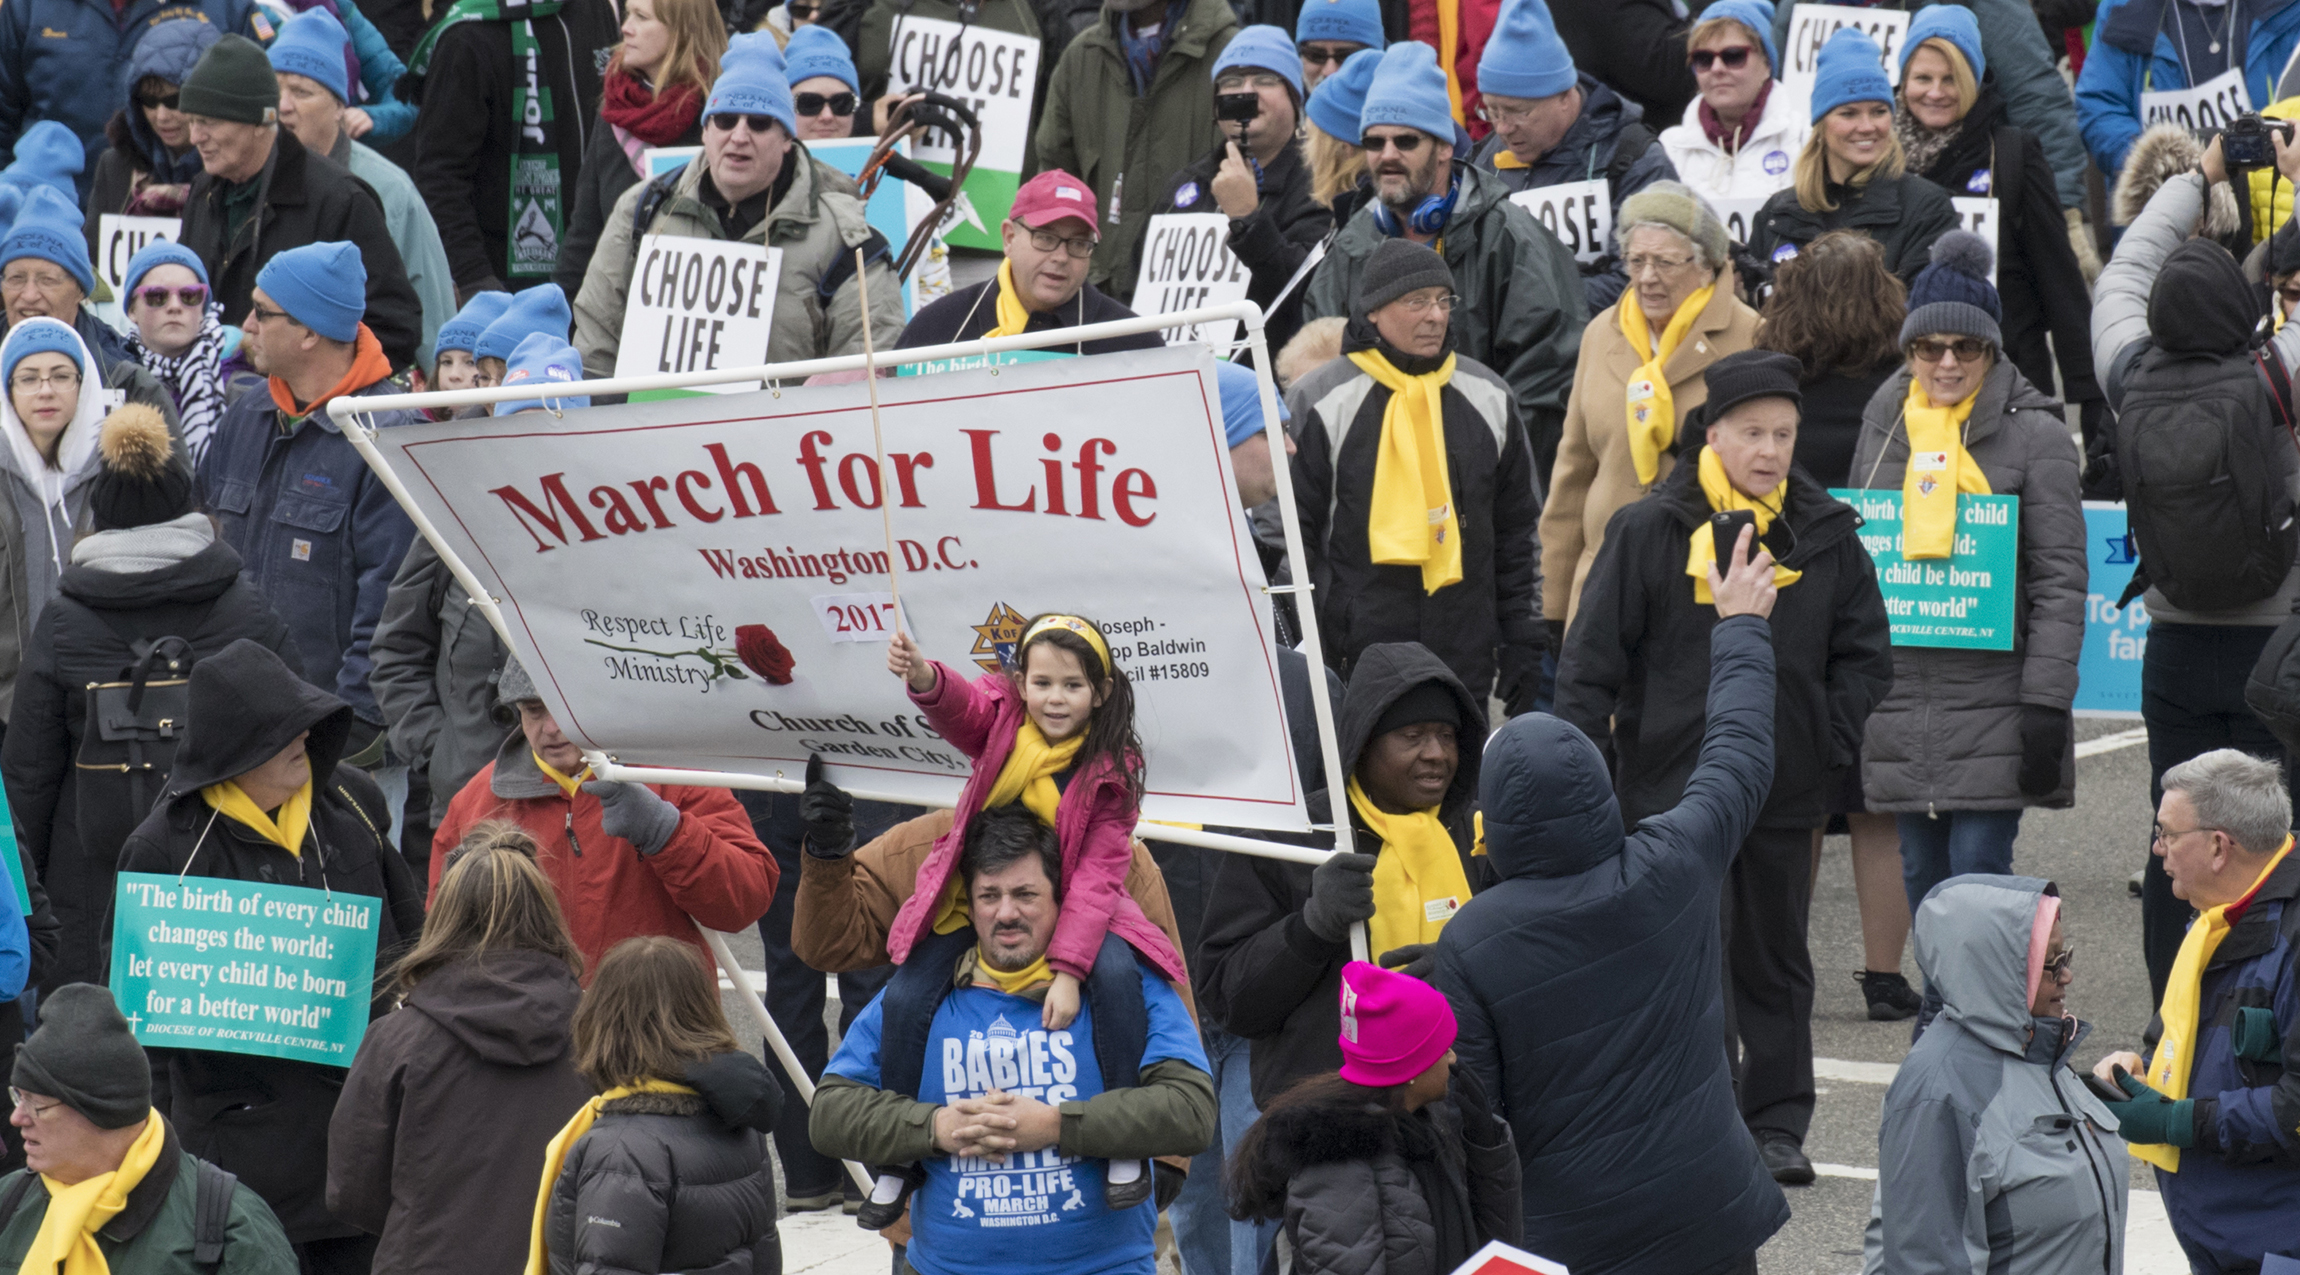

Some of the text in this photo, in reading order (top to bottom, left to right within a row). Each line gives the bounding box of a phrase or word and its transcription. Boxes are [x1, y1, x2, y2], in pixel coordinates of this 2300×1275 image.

[900, 30, 1026, 99] CHOOSE
[1522, 194, 1603, 254] OSE
[641, 248, 768, 319] CHOOSE
[658, 314, 725, 374] LIFE
[488, 428, 1157, 554] March for Life
[1863, 498, 1896, 521] birth
[1964, 503, 2008, 526] child
[697, 535, 979, 586] Washington D.C.
[1885, 562, 1922, 585] child
[1925, 564, 1945, 586] be
[1949, 565, 1992, 589] born
[1884, 595, 1978, 619] tter world"
[2087, 593, 2121, 625] To
[580, 608, 727, 649] Respect Life
[1890, 624, 1996, 638] OCKVILLE CENTRE, NY
[1137, 638, 1206, 659] Baldwin
[604, 656, 711, 694] Ministry
[1150, 661, 1210, 682] #15809
[749, 709, 943, 740] Church of S
[798, 738, 966, 770] Garden City,
[126, 883, 370, 930] "The birth of every child
[148, 920, 335, 961] changes the world:
[128, 953, 347, 999] let every child be born
[145, 989, 332, 1030] for a better world"
[145, 1022, 346, 1054] DIOCESE OF ROCKVILLE CENTRE, NY
[969, 1029, 984, 1039] 20
[942, 1030, 1077, 1094] BABIES
[950, 1144, 1082, 1173] MATTE
[957, 1169, 1076, 1199] PRO-LIFE
[979, 1212, 1060, 1228] WASHINGTON D.C.
[983, 1195, 1049, 1213] MARCH
